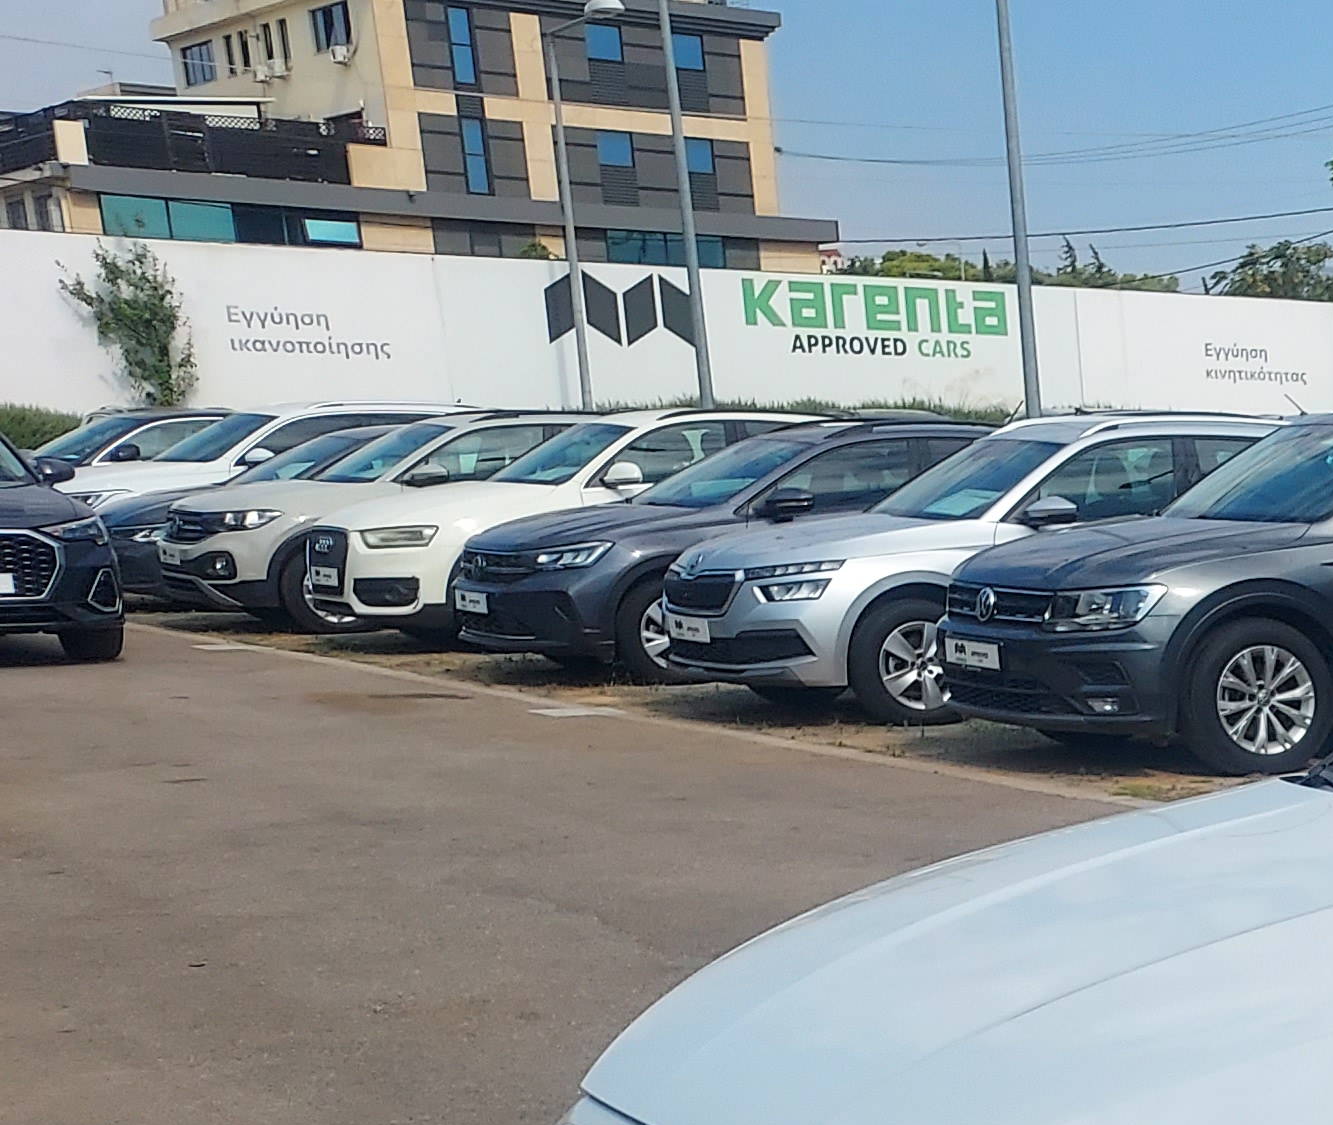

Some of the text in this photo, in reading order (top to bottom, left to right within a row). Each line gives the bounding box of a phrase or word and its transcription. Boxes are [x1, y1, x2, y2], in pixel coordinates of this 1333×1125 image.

[226, 304, 330, 331] Εγγύηση
[230, 335, 391, 360] ικανοποίησης
[791, 333, 971, 359] APPROVED CARS
[1204, 342, 1268, 363] Εγγύηση
[1206, 366, 1307, 386] κινητικότητας
